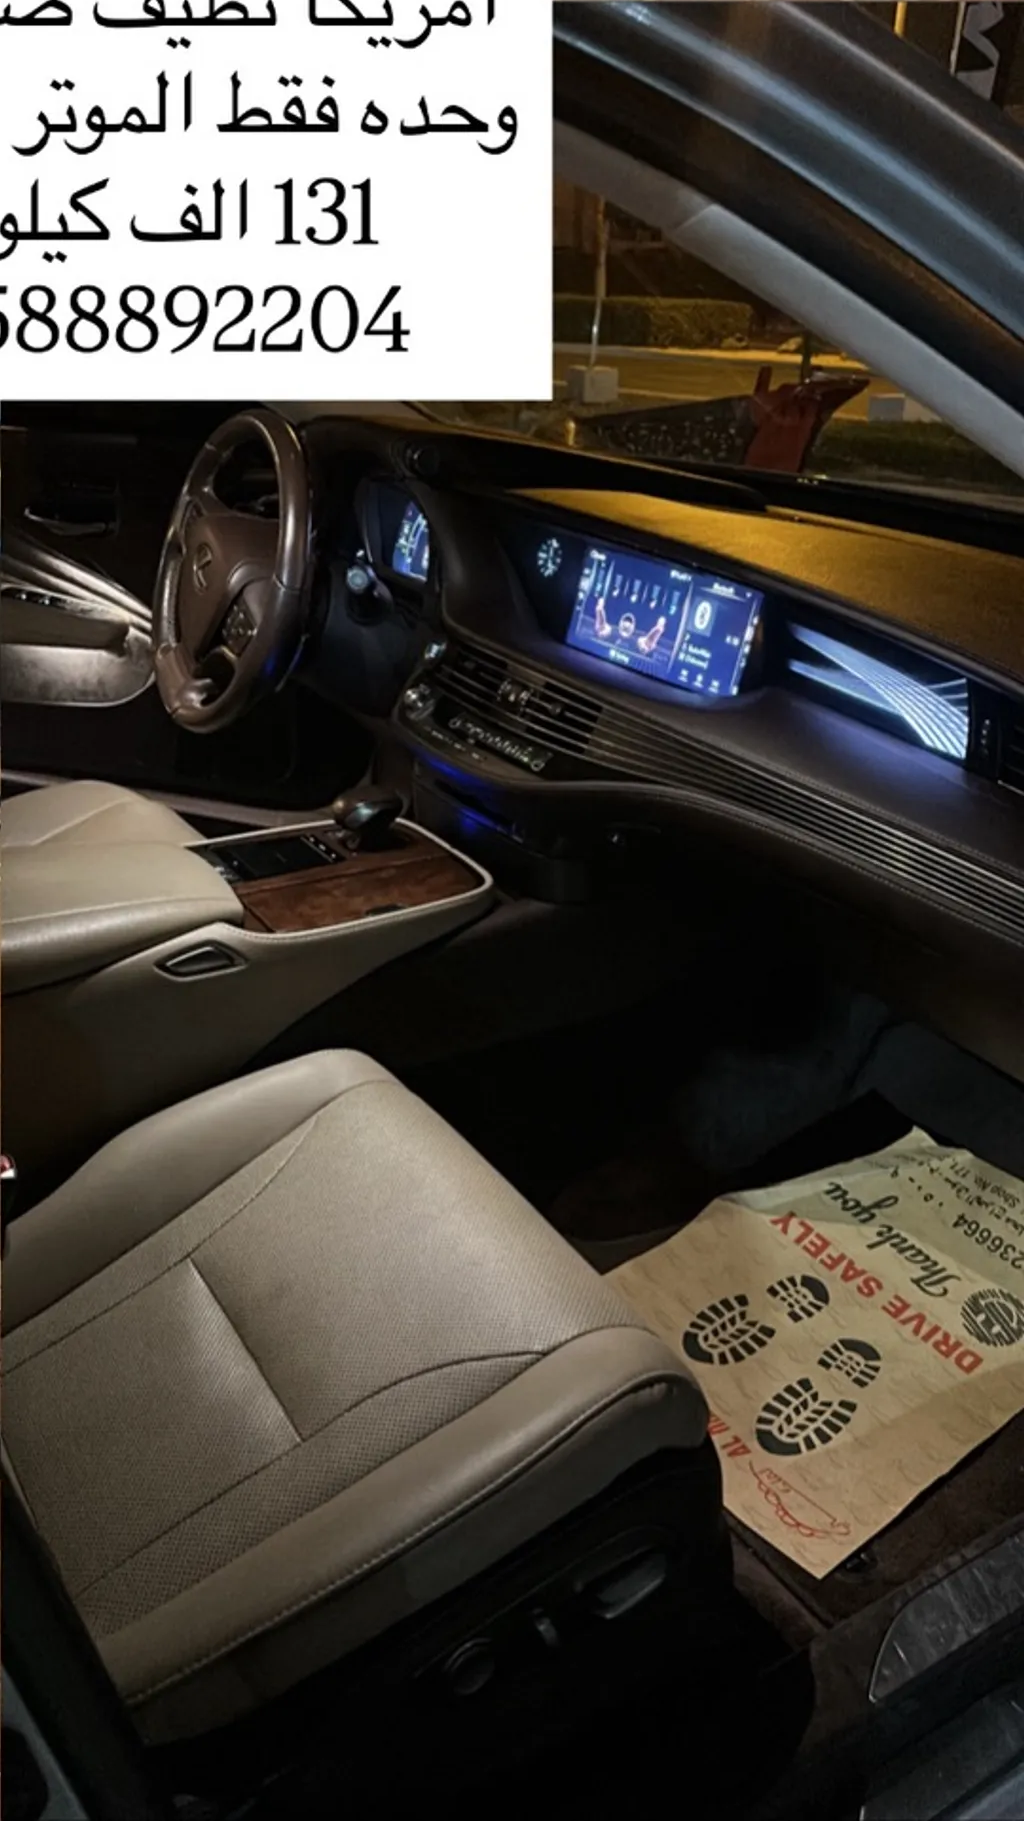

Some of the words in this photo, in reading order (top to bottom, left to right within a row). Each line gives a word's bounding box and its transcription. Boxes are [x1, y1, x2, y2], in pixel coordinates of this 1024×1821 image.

[823, 1181, 899, 1224] you
[769, 1209, 884, 1299] SAFELY
[865, 1223, 962, 1298] Thank
[880, 1293, 984, 1375] DRIVE
